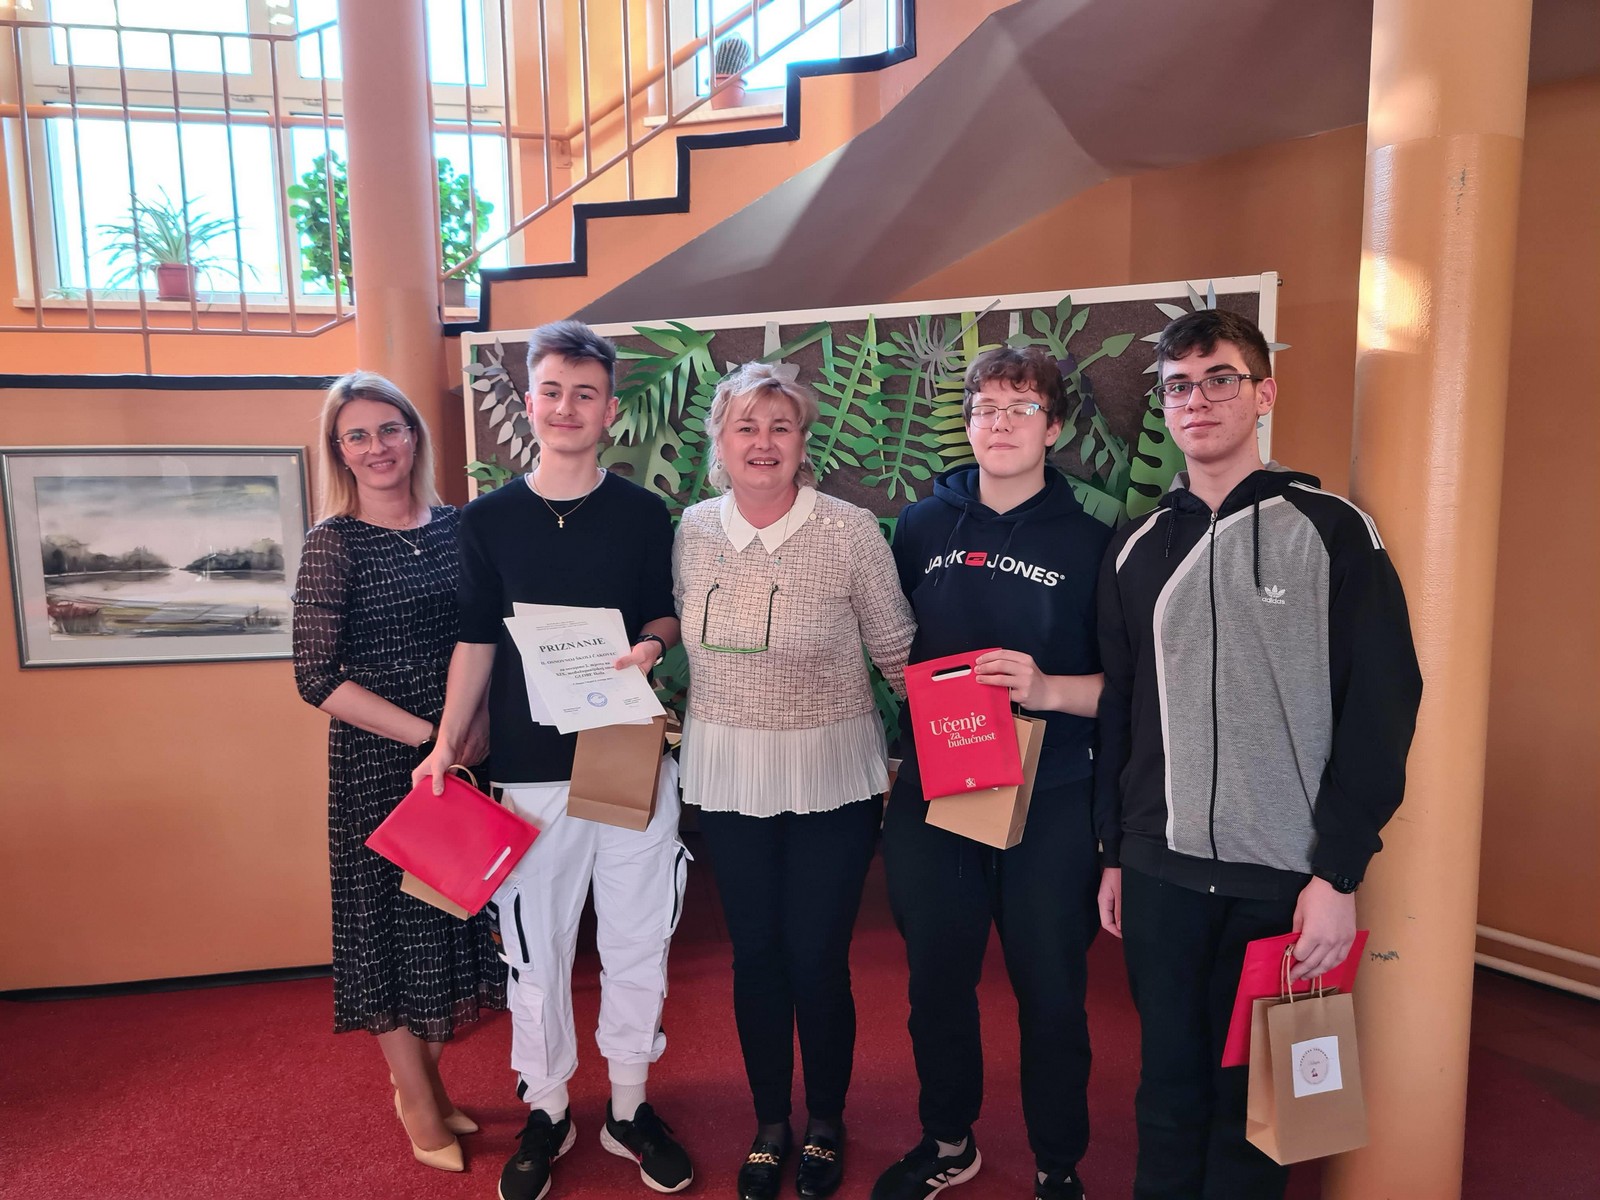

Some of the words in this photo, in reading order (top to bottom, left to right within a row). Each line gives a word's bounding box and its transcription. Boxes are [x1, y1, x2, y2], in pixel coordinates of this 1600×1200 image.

[539, 637, 606, 653] PRIZNANJE
[929, 711, 987, 736] Učenje
[947, 732, 997, 748] budućnost
[949, 732, 961, 740] za
